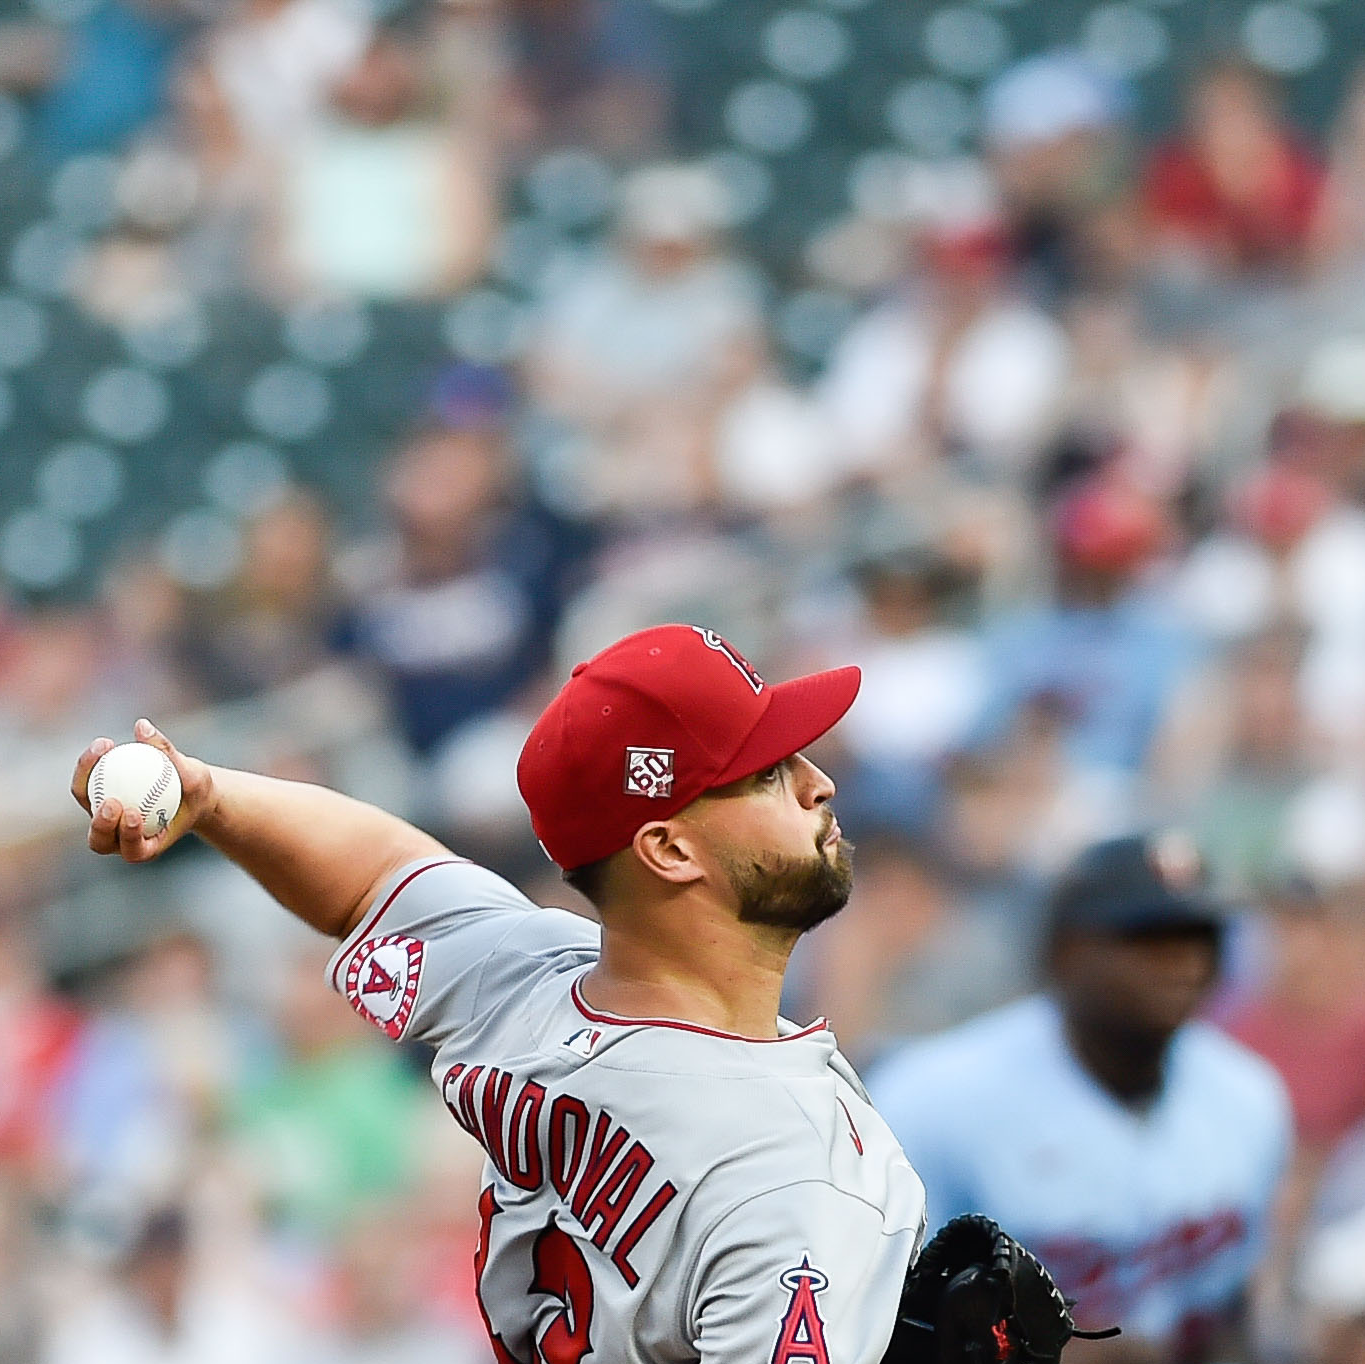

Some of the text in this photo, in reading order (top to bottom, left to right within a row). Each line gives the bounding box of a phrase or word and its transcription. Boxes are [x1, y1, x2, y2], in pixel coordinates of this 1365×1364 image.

[629, 753, 670, 791] 60
[362, 957, 402, 1001] A
[394, 950, 422, 1031] ANGELS
